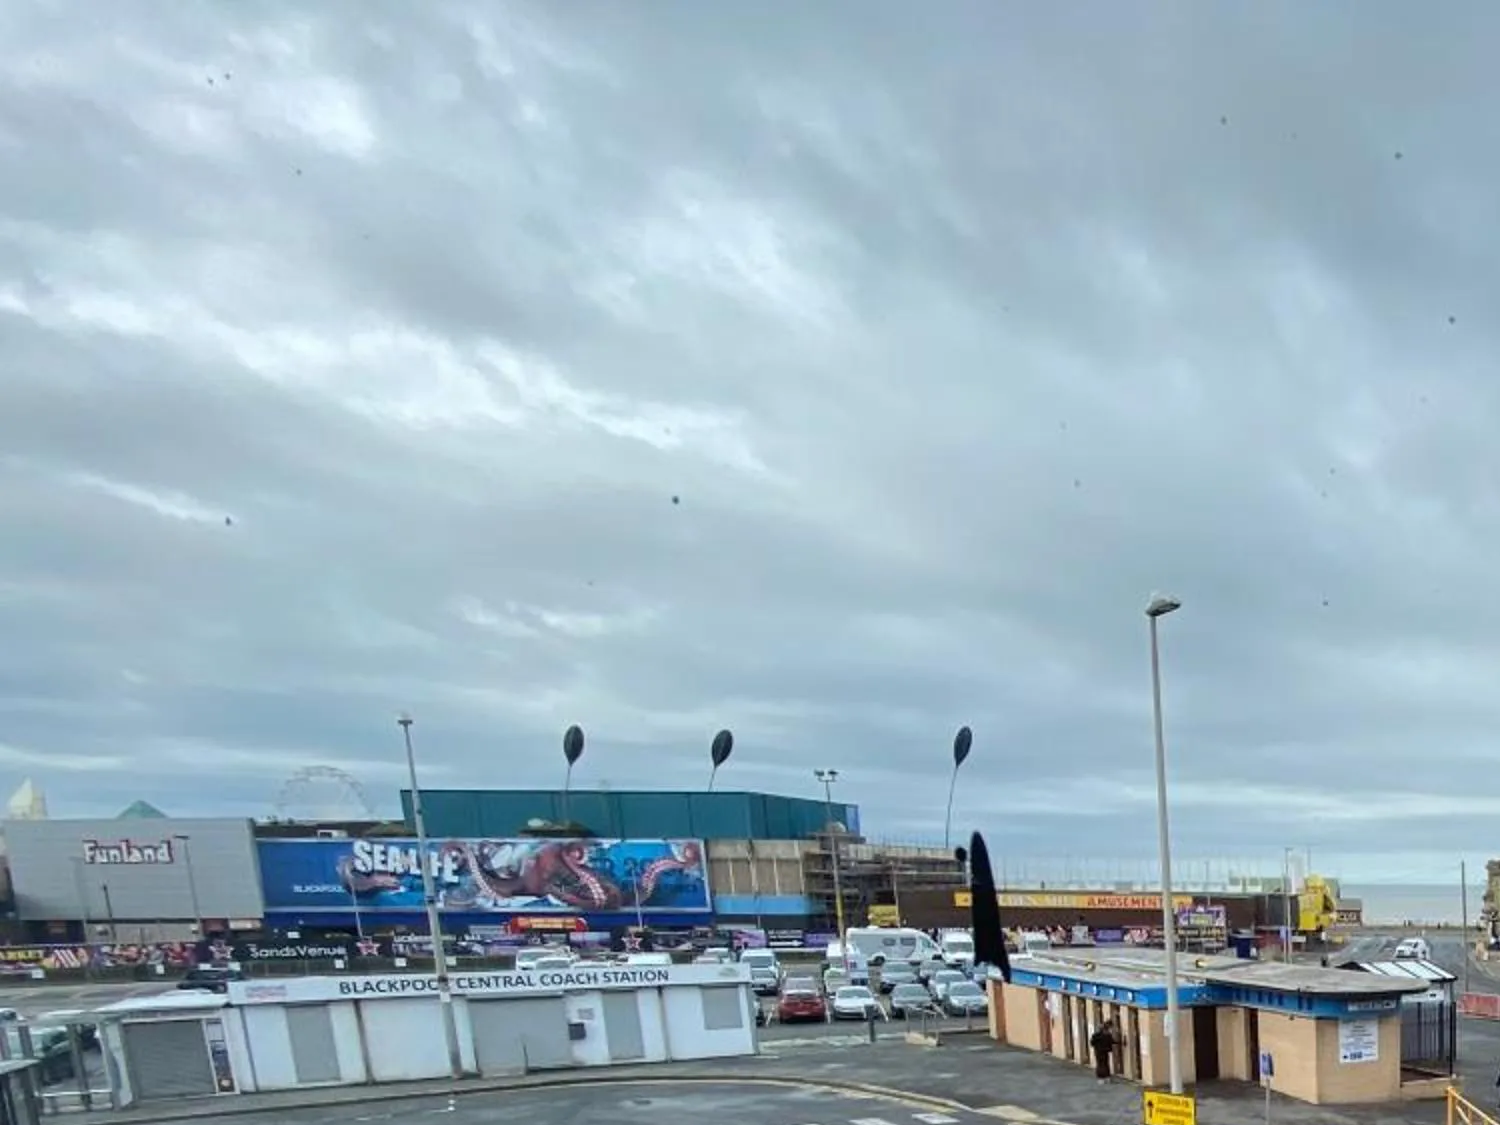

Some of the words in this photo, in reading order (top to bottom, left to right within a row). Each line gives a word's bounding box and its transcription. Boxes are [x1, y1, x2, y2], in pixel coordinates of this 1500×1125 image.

[82, 839, 173, 865] Funland
[353, 840, 404, 874] SEA
[409, 848, 460, 882] LFE
[339, 978, 445, 994] BLACKPOO
[456, 975, 535, 989] CENTRAL
[540, 972, 599, 986] COACH
[603, 970, 669, 984] STATION
